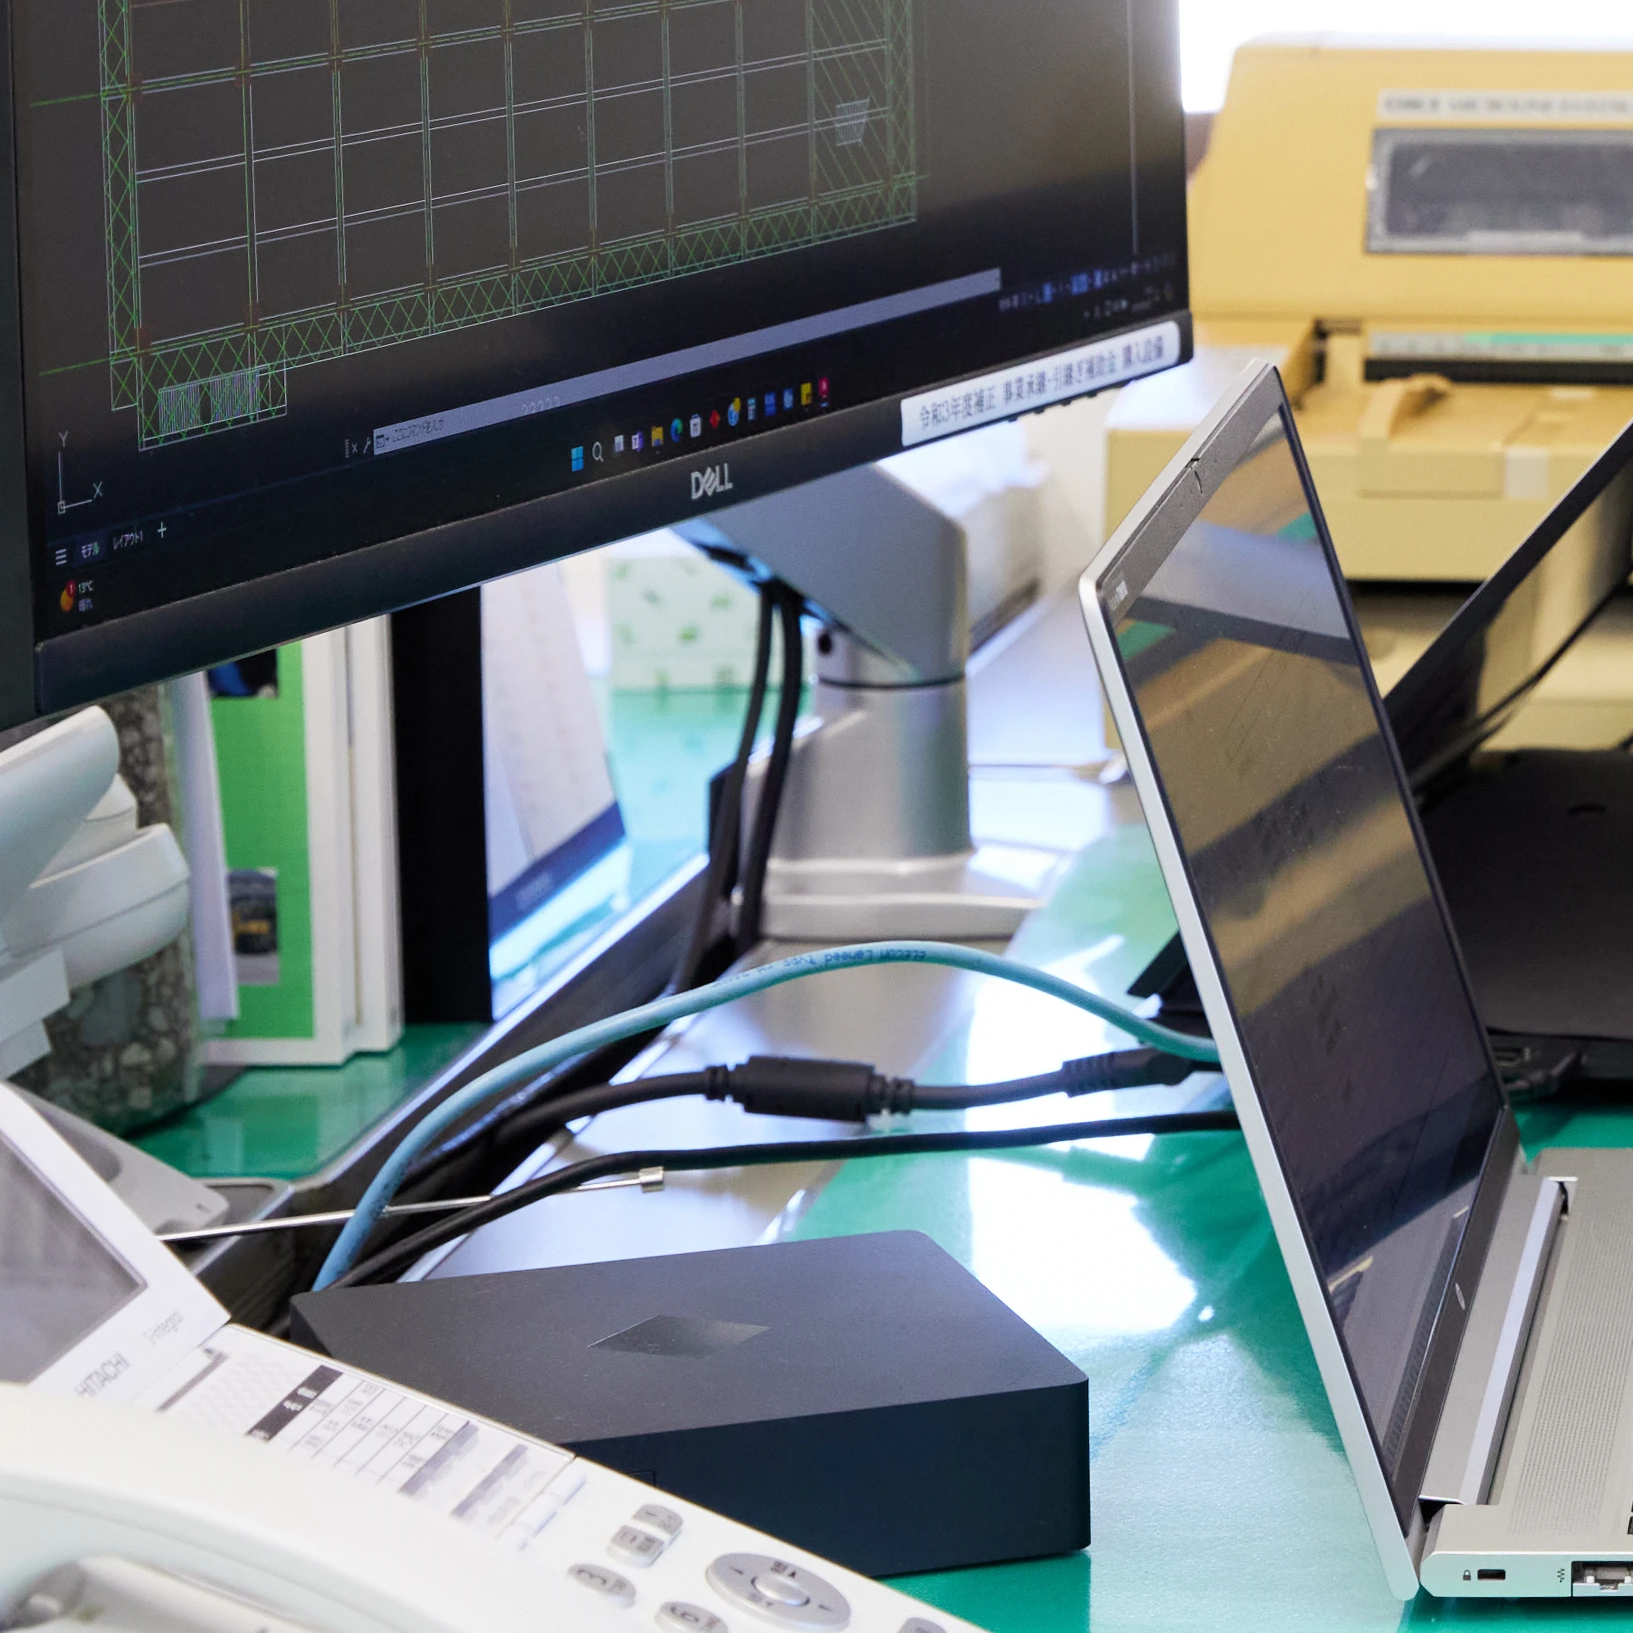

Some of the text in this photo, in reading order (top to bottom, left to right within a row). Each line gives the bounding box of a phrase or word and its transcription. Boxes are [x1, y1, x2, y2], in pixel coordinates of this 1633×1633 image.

[59, 431, 69, 447] Y
[93, 481, 103, 497] X
[691, 463, 733, 500] DELL
[81, 541, 100, 559] モデル
[824, 950, 873, 963] Laneed
[74, 1350, 130, 1398] HITACHI
[576, 1569, 607, 1586] 3
[670, 1606, 700, 1624] 6
